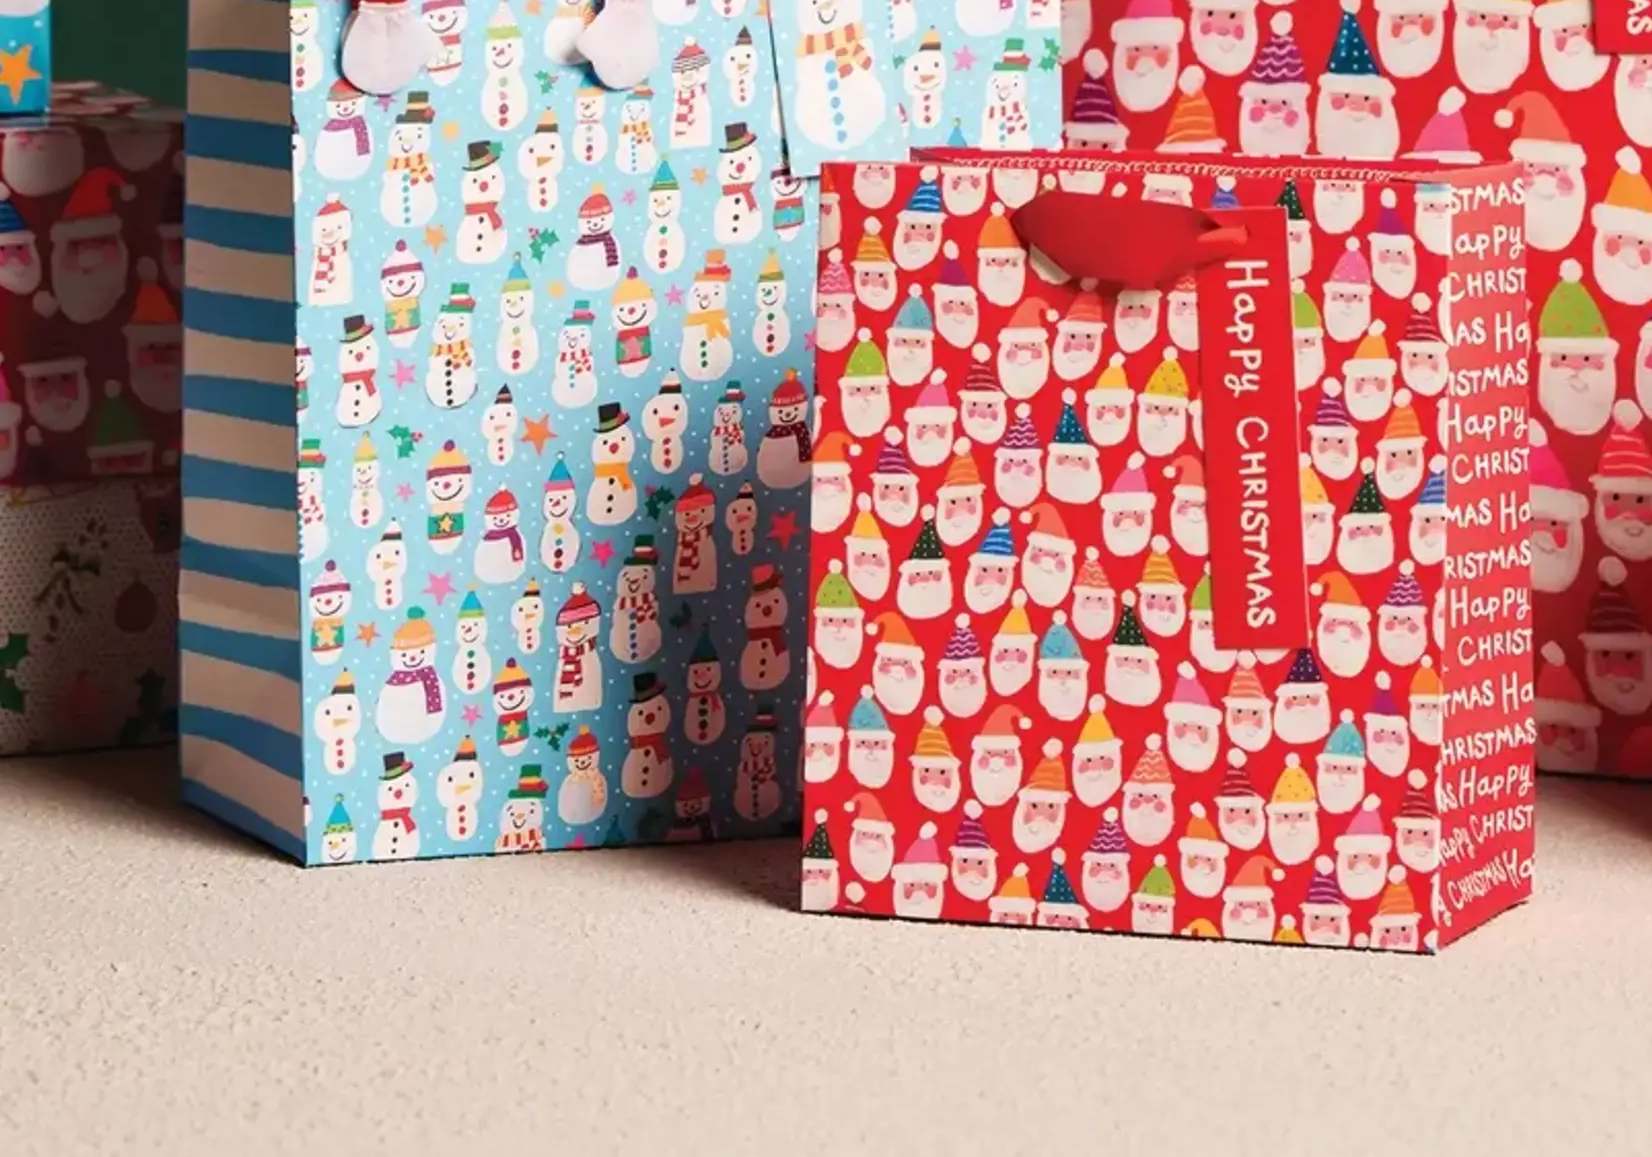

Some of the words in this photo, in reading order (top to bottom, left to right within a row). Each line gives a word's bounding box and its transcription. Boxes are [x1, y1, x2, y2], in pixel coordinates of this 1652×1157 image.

[1450, 224, 1525, 260] appy
[1448, 267, 1527, 303] CHRIST
[1224, 259, 1270, 398] Happy
[1446, 403, 1528, 443] Happy
[1452, 447, 1530, 484] CHRIST
[1235, 415, 1278, 629] CHRISTMAS
[1444, 539, 1532, 580] RISTMAS
[1450, 586, 1531, 628] Happy
[1457, 628, 1533, 666] CHRIST
[1459, 764, 1534, 807] Happy
[1439, 827, 1475, 866] appy
[1447, 856, 1507, 910] CHRISTMAS
